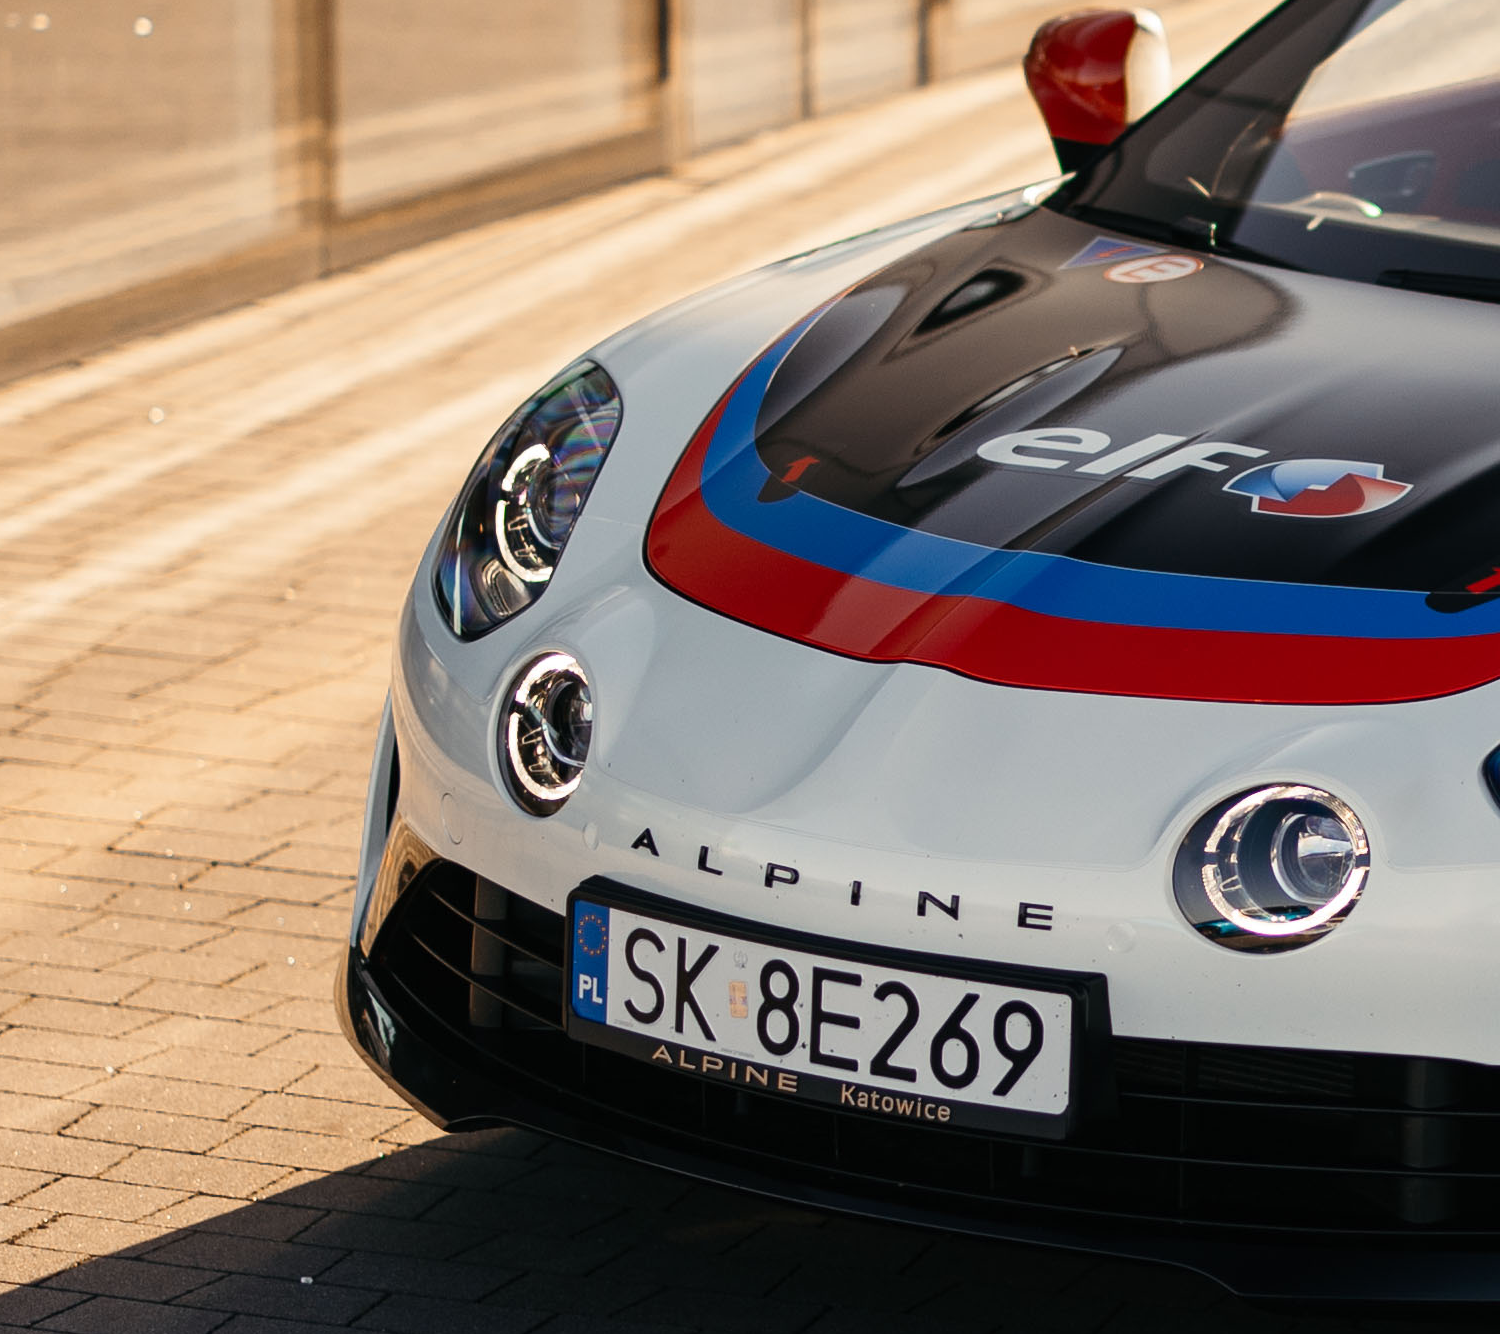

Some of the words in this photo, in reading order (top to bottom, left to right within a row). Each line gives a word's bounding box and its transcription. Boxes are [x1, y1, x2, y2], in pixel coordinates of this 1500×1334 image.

[976, 427, 1271, 480] elf
[630, 827, 1055, 932] ALPINE
[577, 973, 604, 1005] PL
[623, 927, 721, 1043] SK
[756, 958, 1045, 1097] 8E269
[651, 1044, 799, 1093] ALPINE
[840, 1082, 952, 1122] Katowice
